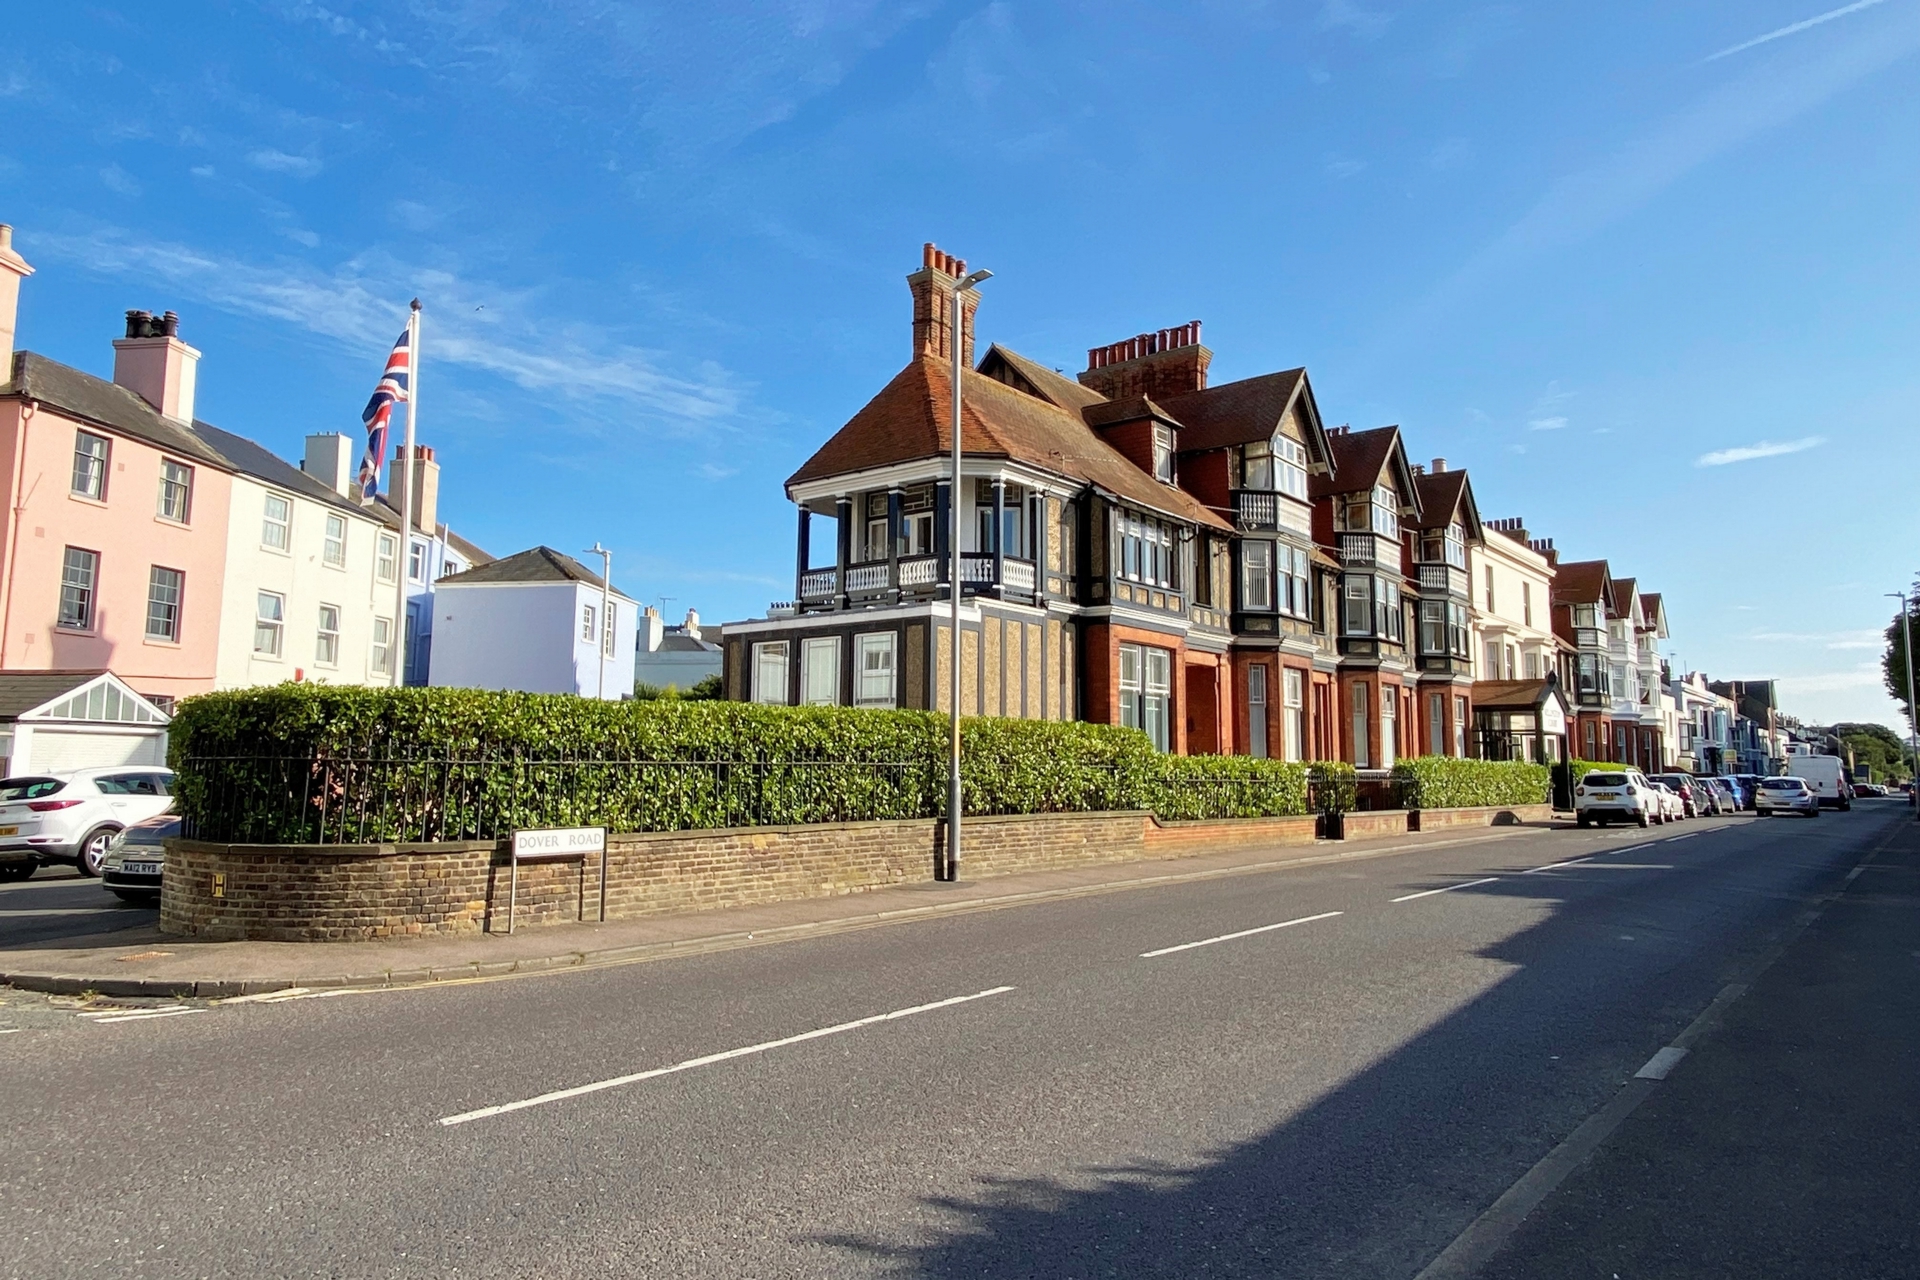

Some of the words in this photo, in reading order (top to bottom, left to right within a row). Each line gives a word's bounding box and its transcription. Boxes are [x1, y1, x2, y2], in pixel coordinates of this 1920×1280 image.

[519, 835, 560, 849] DOVER
[568, 833, 602, 846] ROAD
[214, 874, 225, 895] H
